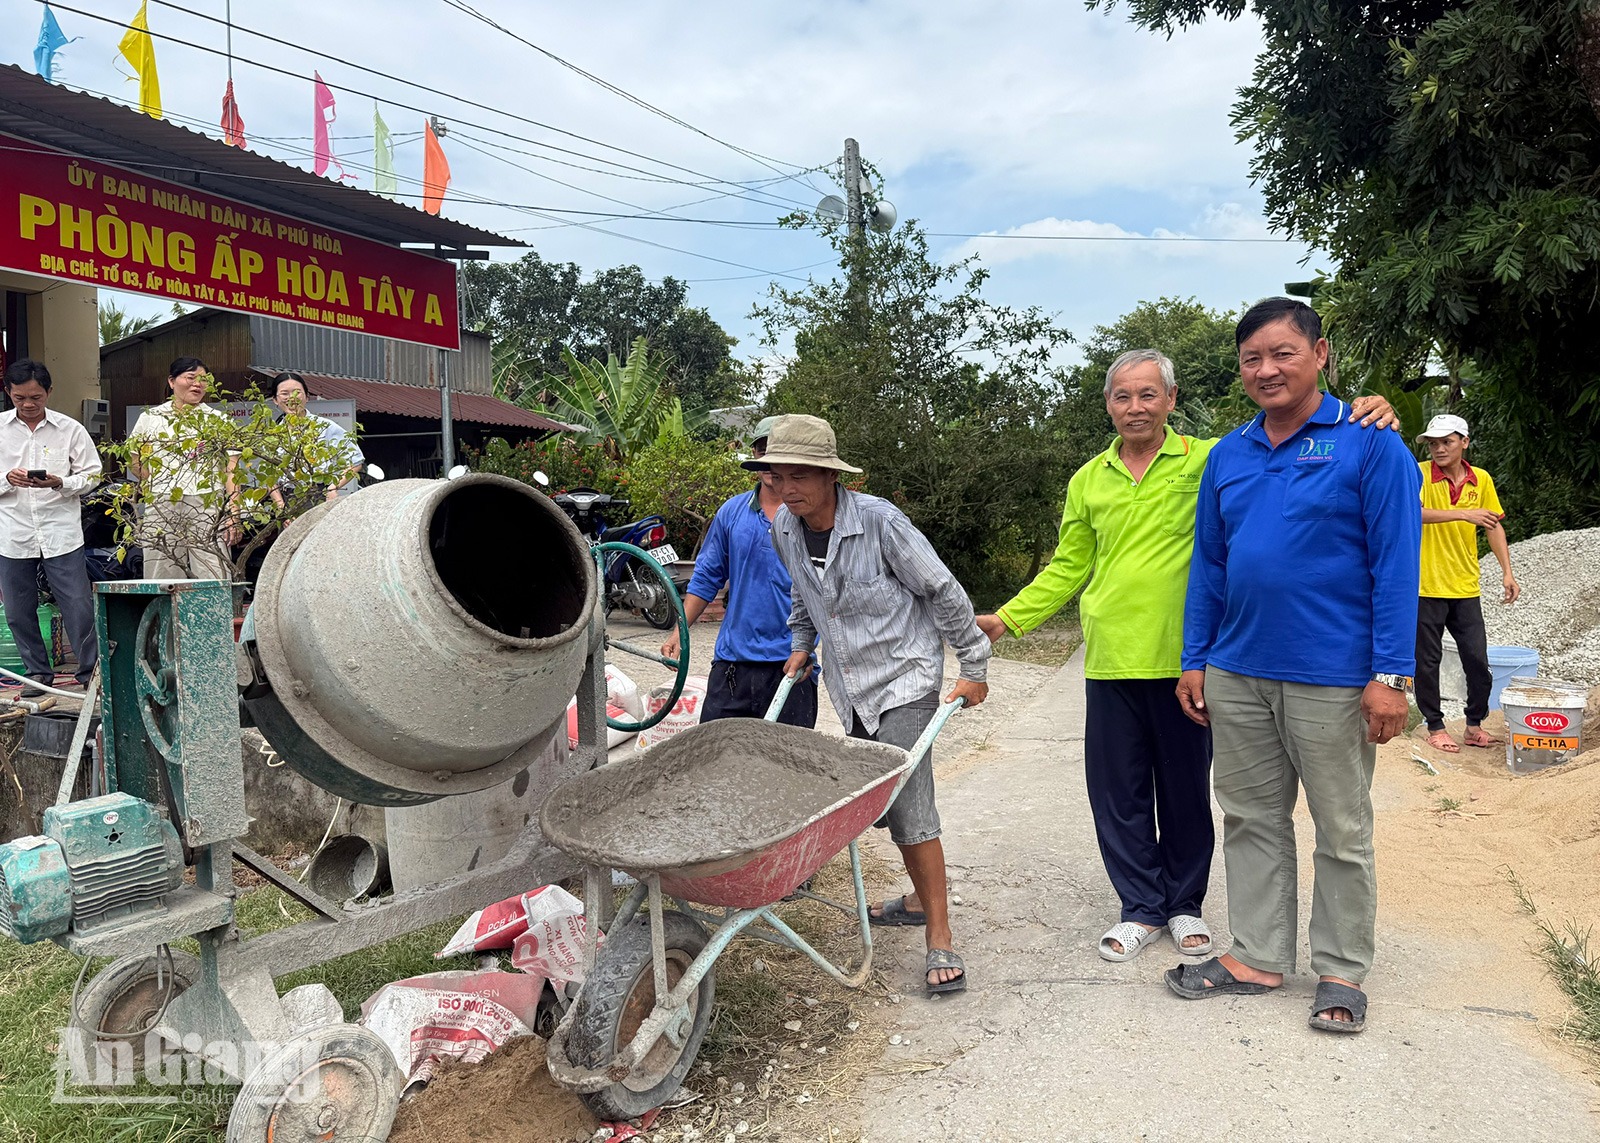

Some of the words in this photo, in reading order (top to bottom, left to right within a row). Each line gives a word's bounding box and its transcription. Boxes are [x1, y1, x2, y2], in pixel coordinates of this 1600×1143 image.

[67, 160, 96, 190] ỦY
[103, 175, 146, 203] BAN
[152, 189, 206, 220] NHÂN
[211, 205, 247, 231] DÂN
[251, 217, 273, 238] XÃ
[277, 223, 308, 247] PHÚ
[313, 233, 343, 256] HÒA
[19, 193, 196, 275] PHÒNG
[210, 232, 264, 286] ẤP
[276, 255, 350, 307] HÒA
[358, 275, 415, 320] TÂY
[424, 293, 443, 326] A
[40, 254, 66, 274] ĐỊA
[69, 259, 99, 279] CHỈ:
[122, 270, 143, 289] 03,
[146, 271, 163, 291] ẤP
[166, 277, 191, 297] HÒA
[193, 283, 215, 301] TÂY
[218, 289, 229, 305] A,
[232, 291, 247, 308] XÃ
[250, 295, 269, 311] PHÚ
[272, 298, 295, 318] HÒA,
[297, 302, 319, 322] TỈNH
[322, 310, 335, 323] AN
[337, 312, 365, 330] GIANG
[1531, 716, 1563, 727] KOVA
[1526, 737, 1567, 748] CT-11A
[487, 918, 505, 933] PCB
[555, 929, 563, 940] XI
[438, 998, 461, 1011] ISO
